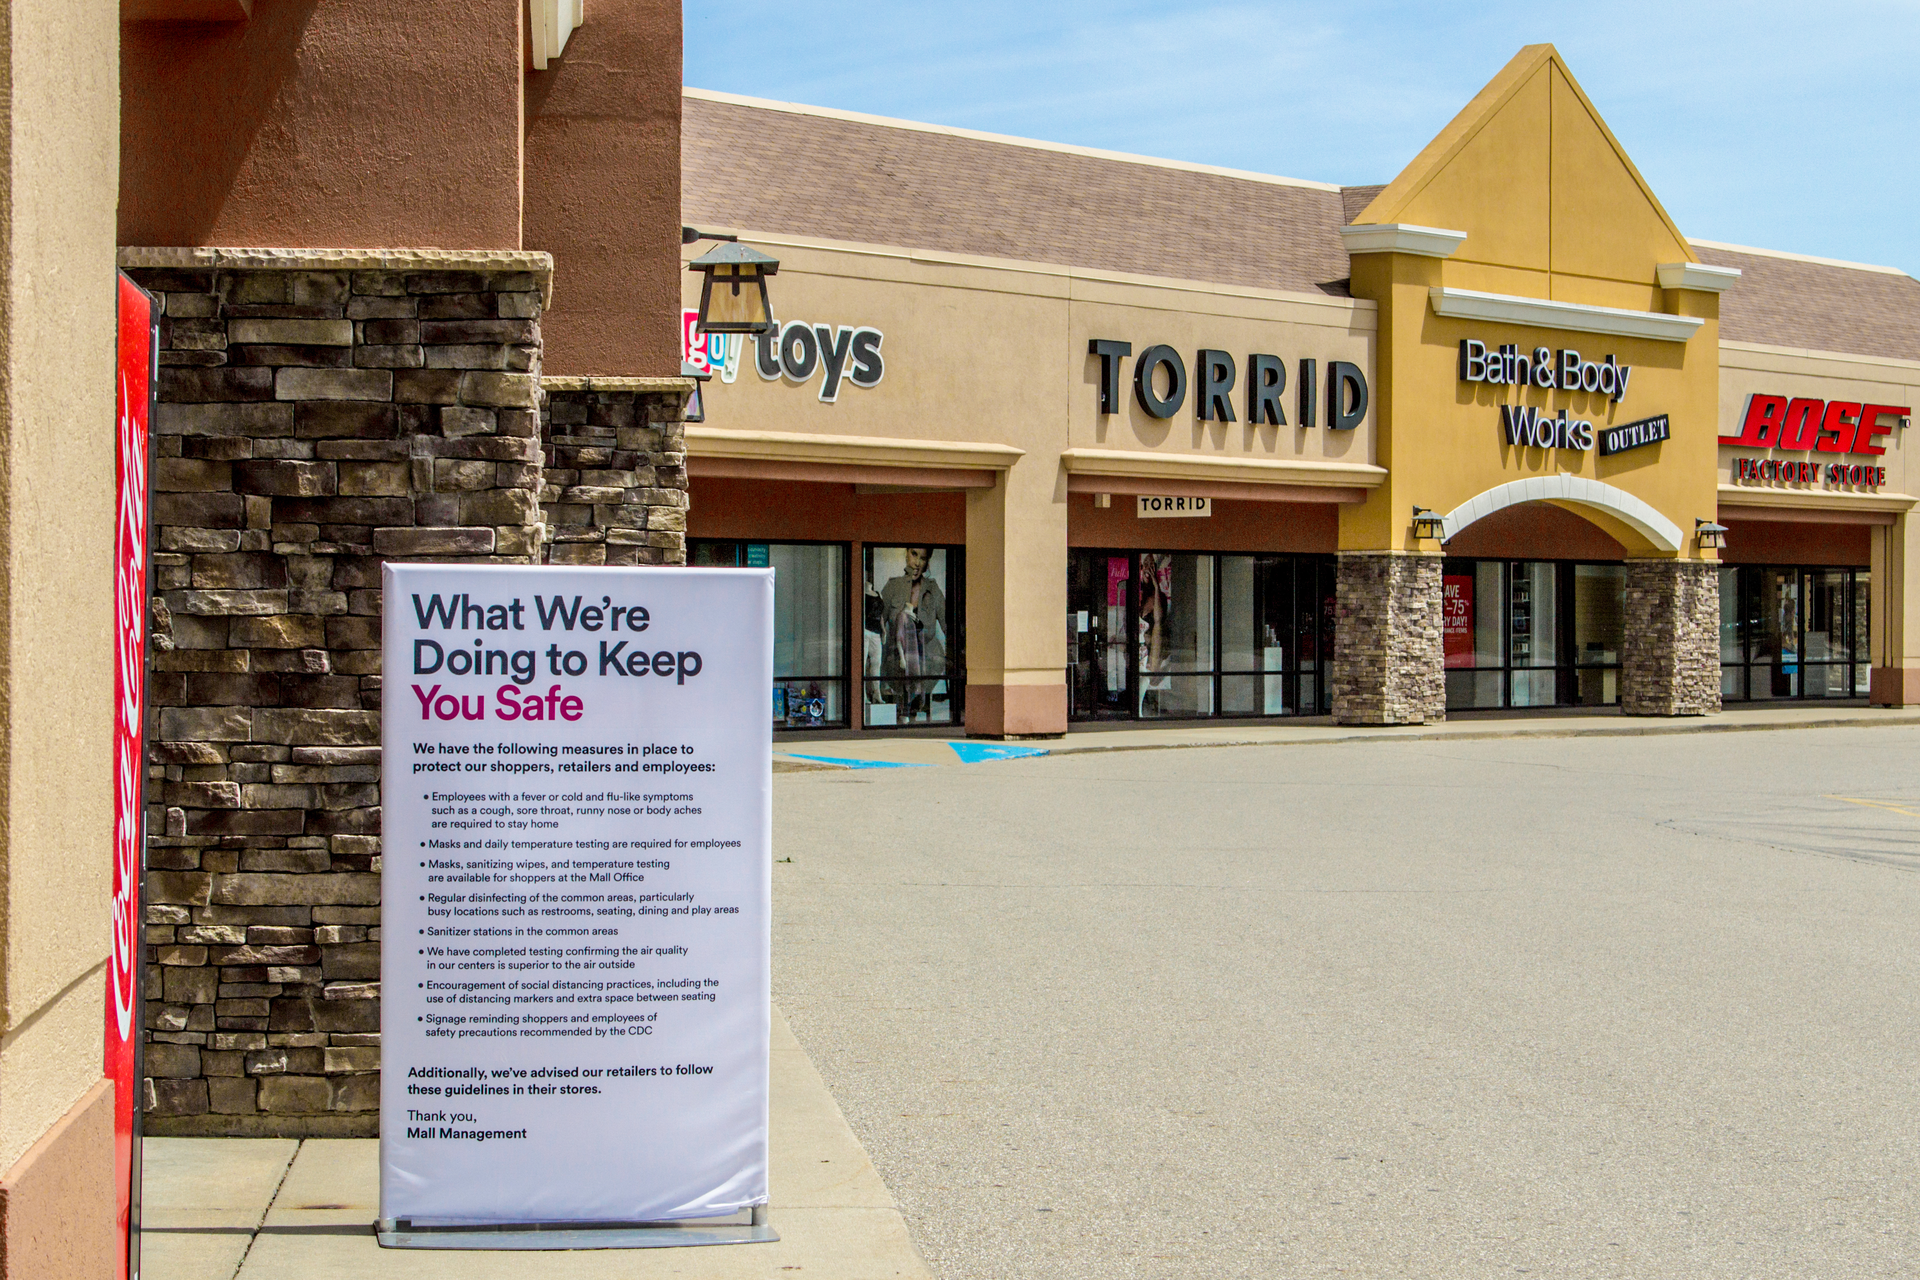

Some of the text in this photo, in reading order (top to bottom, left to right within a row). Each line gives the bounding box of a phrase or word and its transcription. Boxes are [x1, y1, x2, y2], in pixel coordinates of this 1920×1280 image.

[753, 318, 884, 402] toys
[1460, 339, 1631, 403] Bath & Body
[1089, 338, 1368, 430] TORRID
[1501, 405, 1594, 451] Works
[1718, 393, 1911, 455] BOSE
[1608, 418, 1667, 451] OUTLET
[1735, 458, 1886, 486] FACTORY STORE
[1141, 497, 1206, 511] TORRID
[1444, 585, 1460, 598] AVE
[412, 594, 650, 632] What We’re
[413, 638, 703, 685] Doing to Keep
[411, 684, 583, 721] You Safe
[413, 742, 694, 757] We have the following measures in place to
[413, 760, 715, 774] protect our shoppers, retailers and employees:
[432, 791, 693, 803] Employees with fever cold and flu-like symptoms
[432, 805, 455, 815] such
[480, 805, 514, 817] cough,
[540, 805, 573, 816] throat,
[577, 808, 605, 817] runny
[647, 805, 671, 816] body
[674, 805, 702, 814] aches
[450, 819, 492, 830] required
[508, 820, 528, 830] stay
[531, 819, 559, 828] home
[429, 838, 741, 851] Masks and daily temperature testing required for employees
[429, 859, 670, 871] Masks, sanitizing wipes, and temperature testing
[446, 872, 644, 884] available for shoppers the Mall Office
[428, 892, 466, 905] Regular
[468, 893, 527, 905] disinfecting
[542, 893, 558, 902] the
[607, 895, 636, 903] areas,
[640, 892, 694, 903] particularly
[428, 906, 452, 918] busy
[454, 906, 499, 916] locations
[502, 906, 525, 916] such
[541, 907, 594, 917] restrooms,
[597, 906, 635, 917] seating,
[638, 905, 668, 917] dining
[671, 905, 689, 915] and
[692, 905, 712, 916] play
[427, 926, 618, 936] Sanitizer stations the common areas
[427, 945, 688, 958] We have completed testing confirming the quality
[438, 959, 635, 971] our centers superior the air outside
[427, 978, 719, 992] Encouragement social distancing practices, including the
[459, 993, 511, 1006] distancing
[514, 993, 554, 1003] markers
[556, 993, 575, 1003] and
[577, 994, 602, 1003] extra
[605, 995, 634, 1004] space
[637, 992, 679, 1002] between
[681, 991, 716, 1002] seating
[426, 1013, 645, 1026] Signage reminding shoppers and employees
[426, 1026, 652, 1039] safety precautions recommended by the CDC
[408, 1064, 713, 1081] Additionally, we’ve advised our retailers to follow
[407, 1083, 601, 1098] these guidelines in their stores.
[407, 1109, 477, 1124] Thank you,
[407, 1127, 527, 1142] Mall Management
